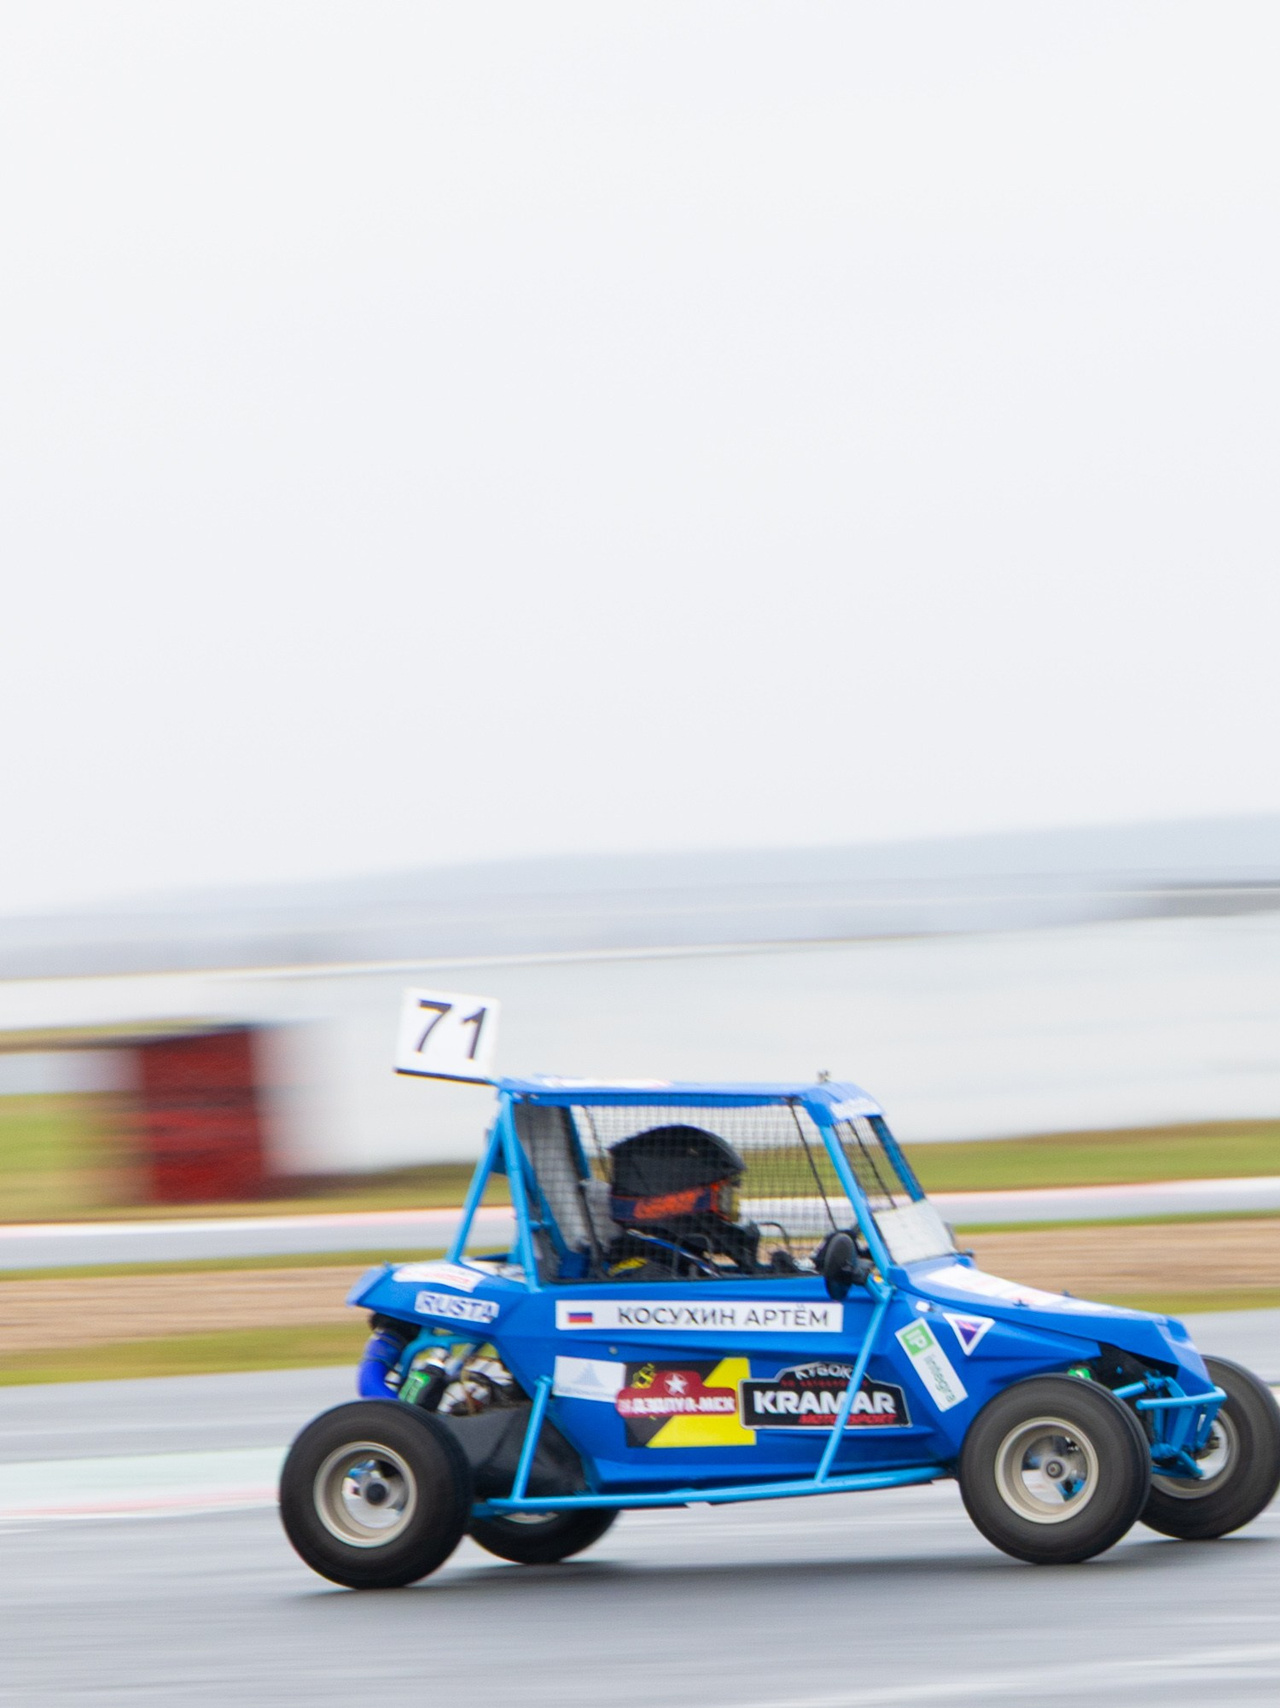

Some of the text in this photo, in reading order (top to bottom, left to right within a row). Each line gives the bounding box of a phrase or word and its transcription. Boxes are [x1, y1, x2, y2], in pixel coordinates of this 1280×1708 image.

[415, 999, 487, 1061] 71
[617, 1303, 829, 1327] КОСУХИН АРТЁМ
[924, 1354, 956, 1403] integra
[753, 1390, 896, 1415] KRAMAR
